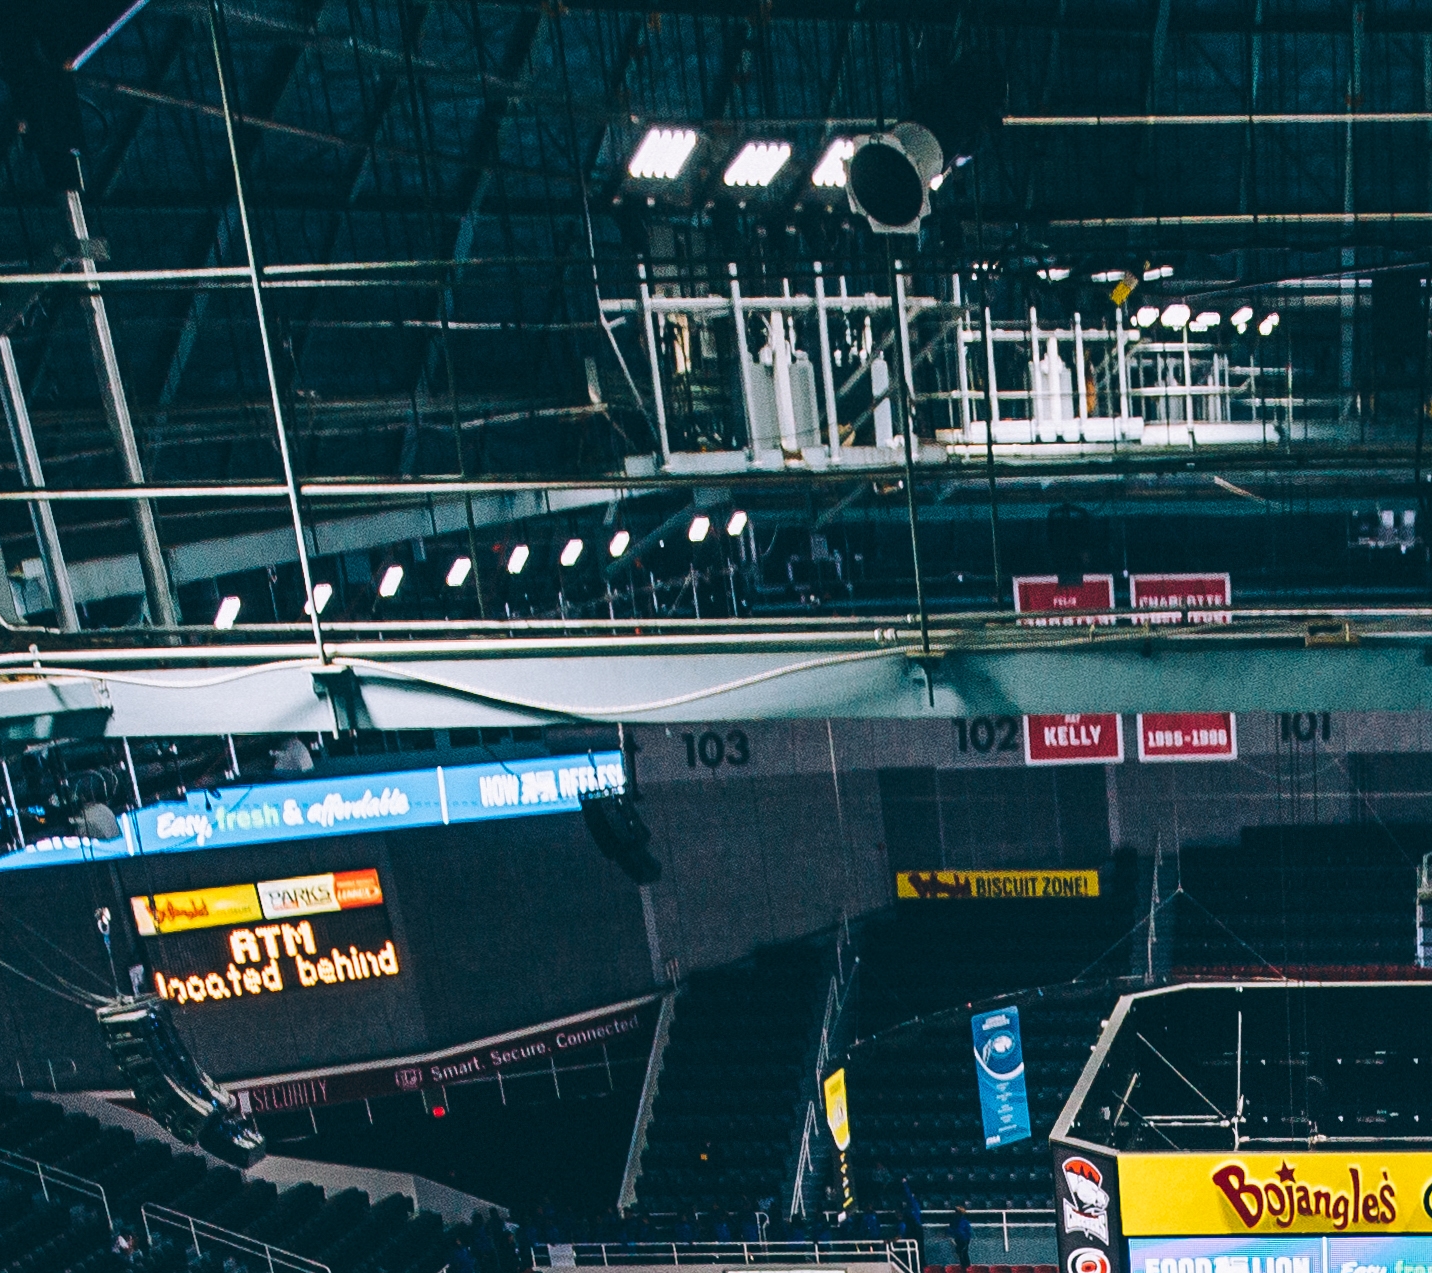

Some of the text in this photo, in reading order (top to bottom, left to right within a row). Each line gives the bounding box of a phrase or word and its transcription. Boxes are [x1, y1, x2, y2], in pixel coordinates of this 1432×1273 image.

[954, 715, 1019, 753] 102
[1043, 724, 1101, 748] KELLY
[1280, 712, 1332, 742] 101
[681, 728, 751, 769] 103
[156, 811, 212, 845] Easy,
[215, 803, 280, 832] fresh
[281, 800, 304, 827] &
[306, 788, 410, 828] affordable
[478, 775, 520, 809] HOW
[267, 885, 333, 906] PARKS
[975, 875, 1038, 897] BISCUIT
[1041, 875, 1089, 896] ZONE!
[229, 919, 318, 965] ATM
[294, 939, 400, 988] behind
[430, 1013, 641, 1083] Smart. Secure. Connected
